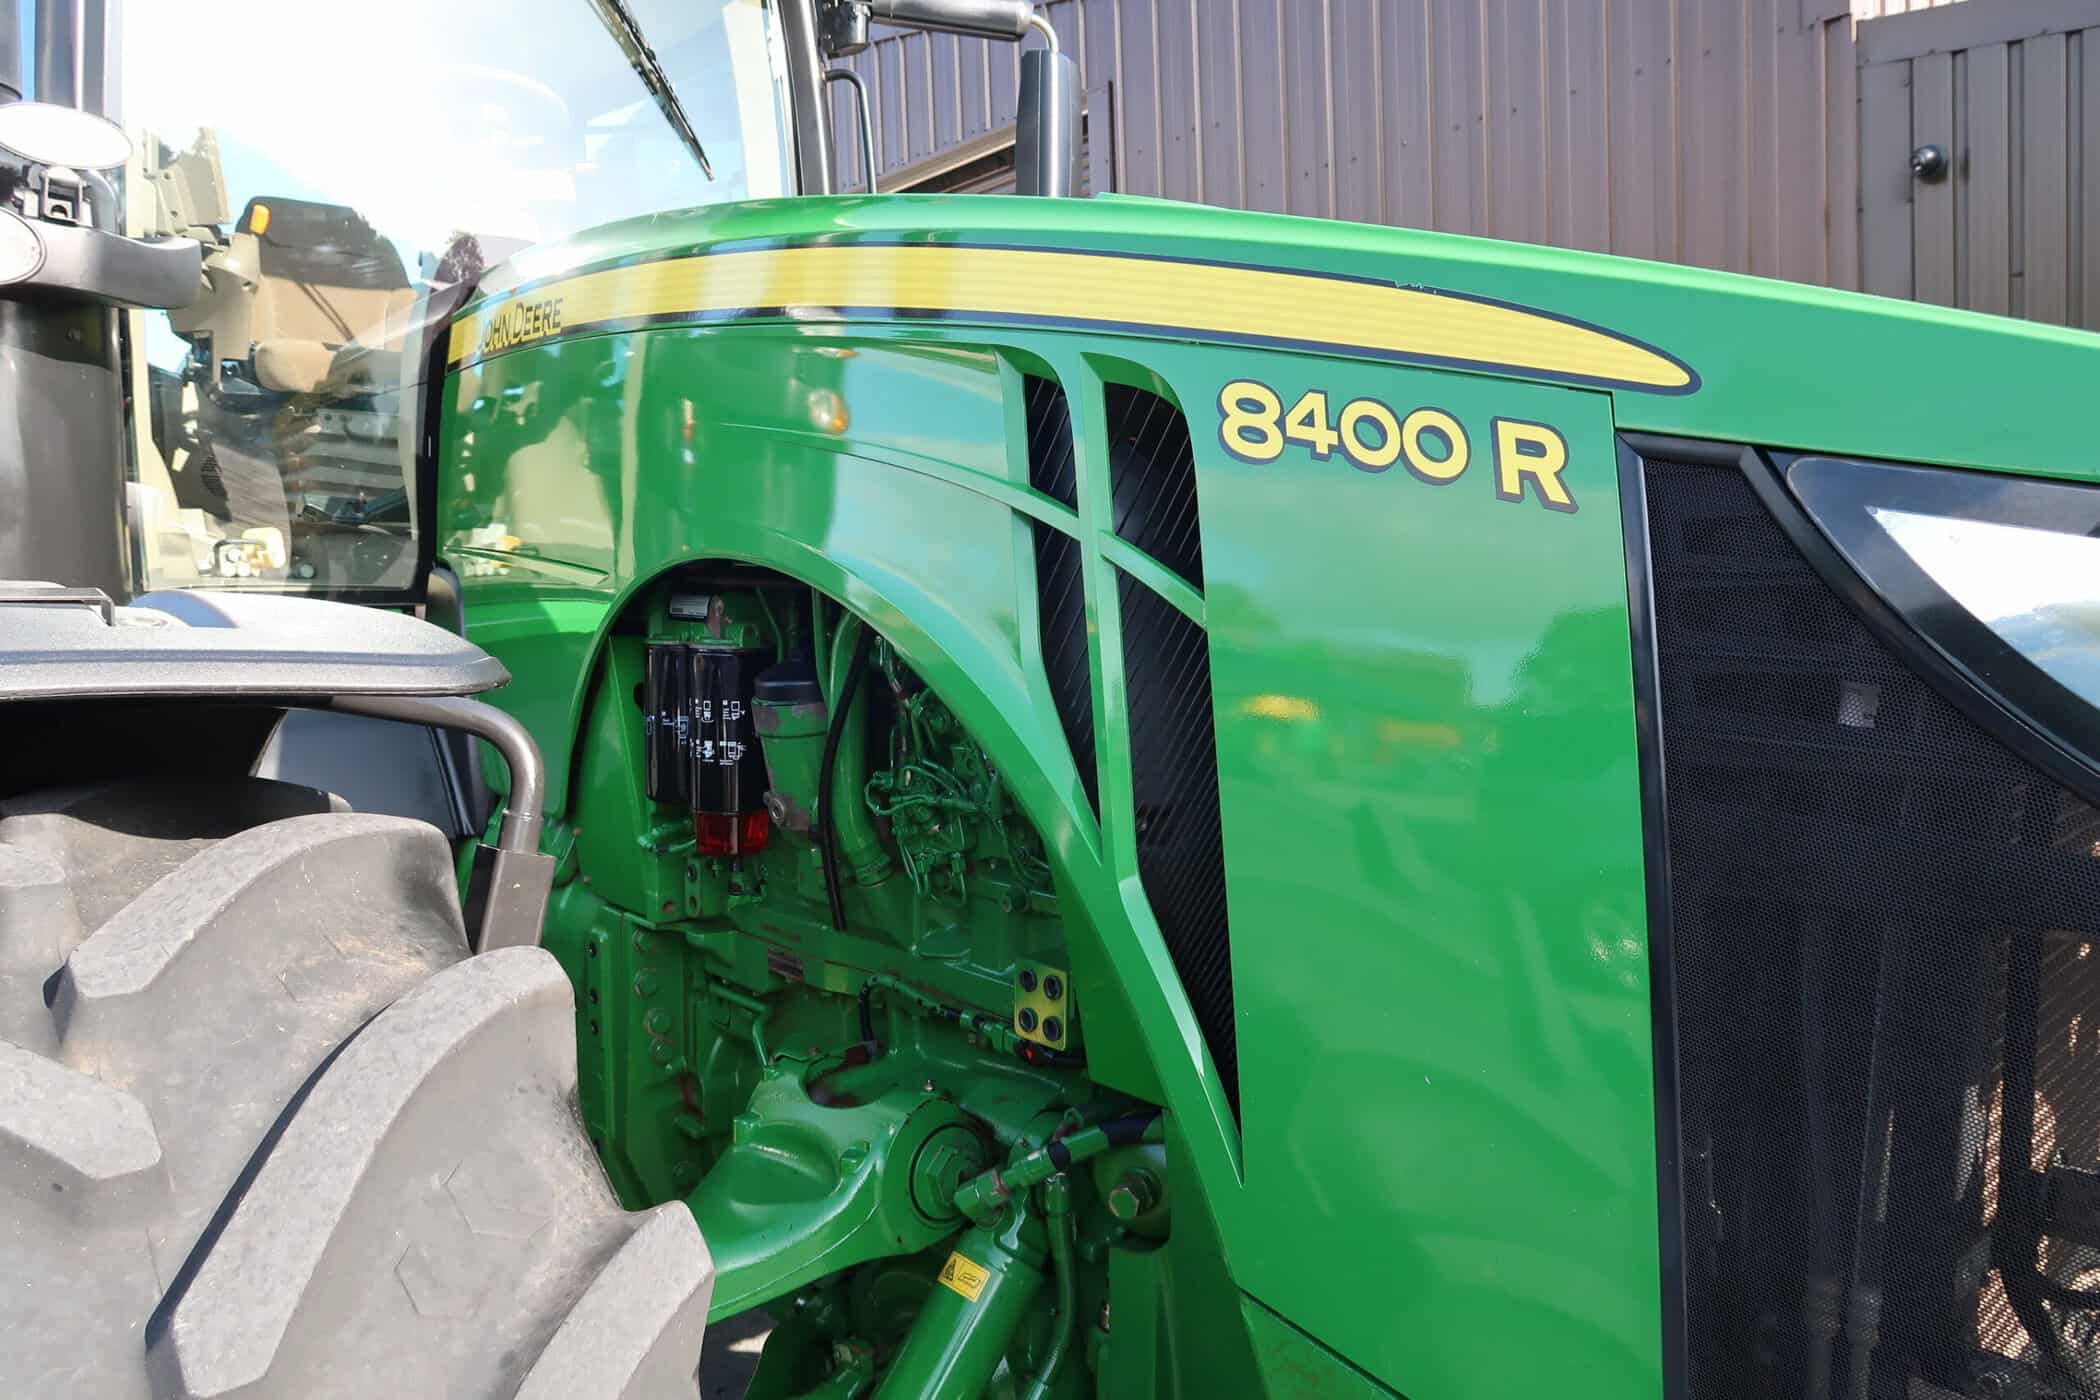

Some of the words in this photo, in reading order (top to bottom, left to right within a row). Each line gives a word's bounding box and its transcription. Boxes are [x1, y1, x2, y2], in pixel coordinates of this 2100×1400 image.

[512, 299, 563, 337] DEERE
[1217, 379, 1471, 485] 8400
[1490, 416, 1579, 513] R
